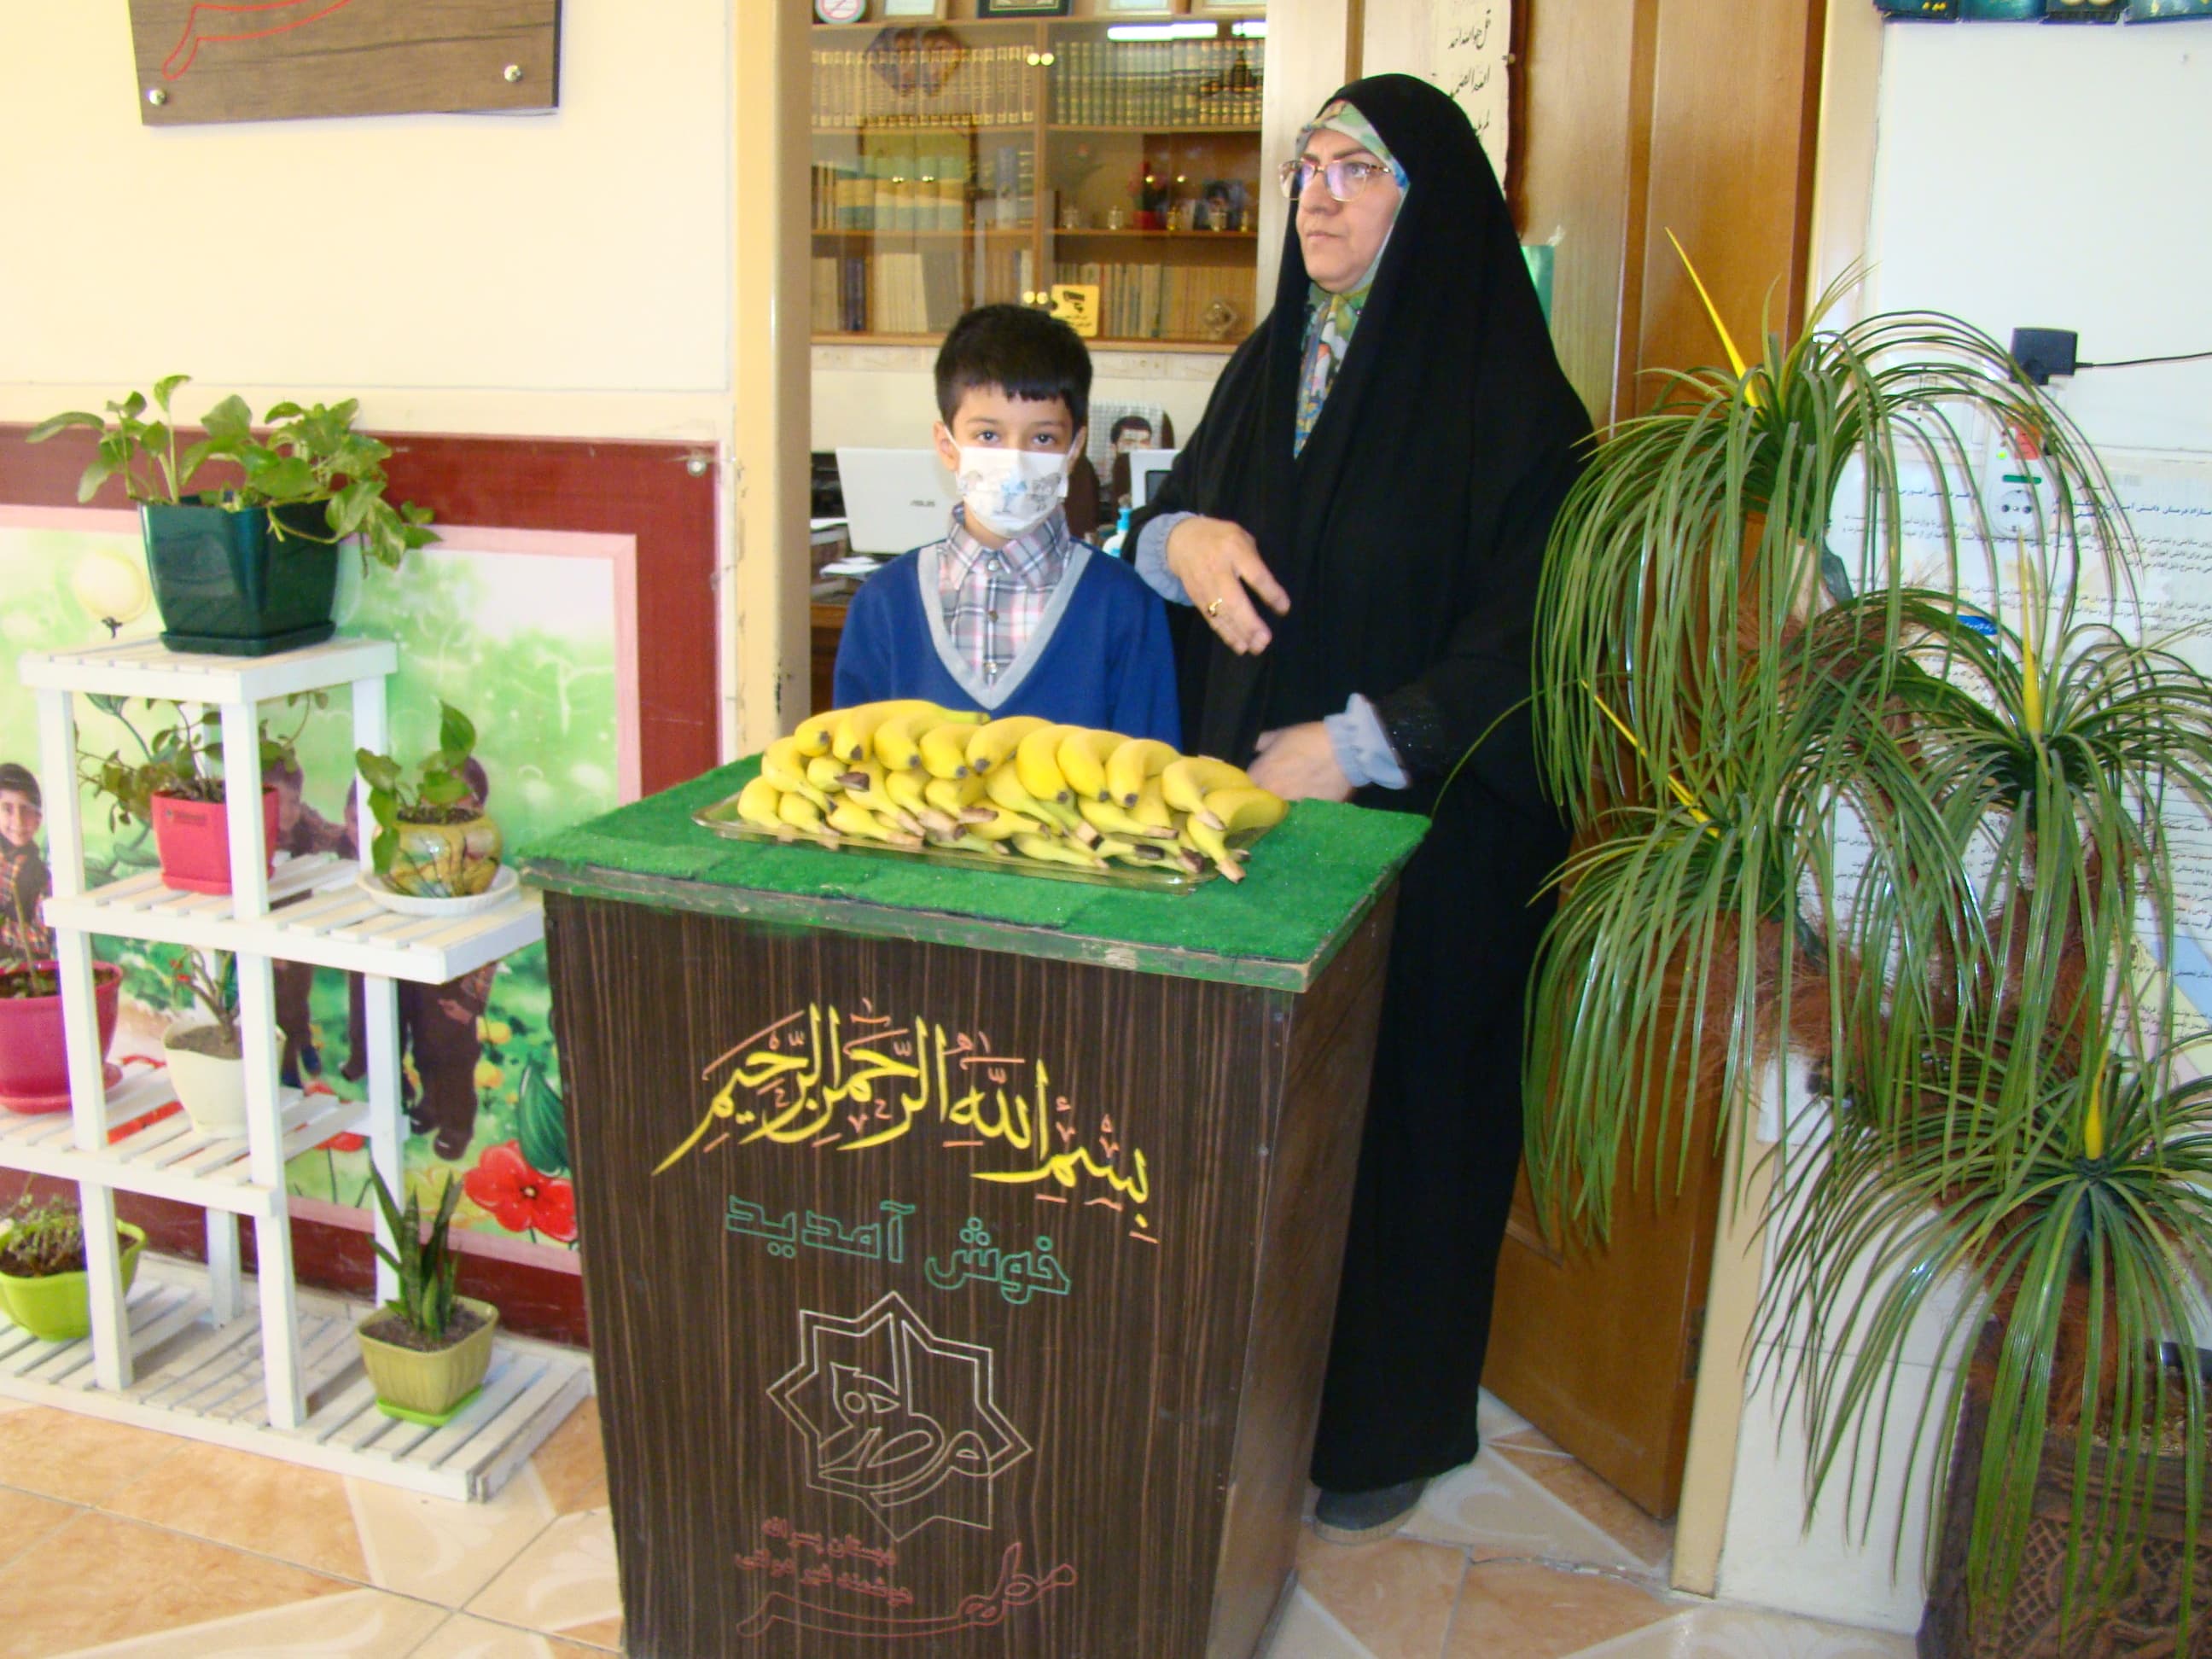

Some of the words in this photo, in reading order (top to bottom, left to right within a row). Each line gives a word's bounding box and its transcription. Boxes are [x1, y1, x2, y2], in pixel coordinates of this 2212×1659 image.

[652, 1003, 841, 1176] الرحیم
[763, 1011, 949, 1152] الرحمن
[946, 1045, 1050, 1159] الله
[725, 1195, 917, 1263] آمدید
[971, 1126, 1154, 1236] بسم
[924, 1216, 1071, 1304] خوش
